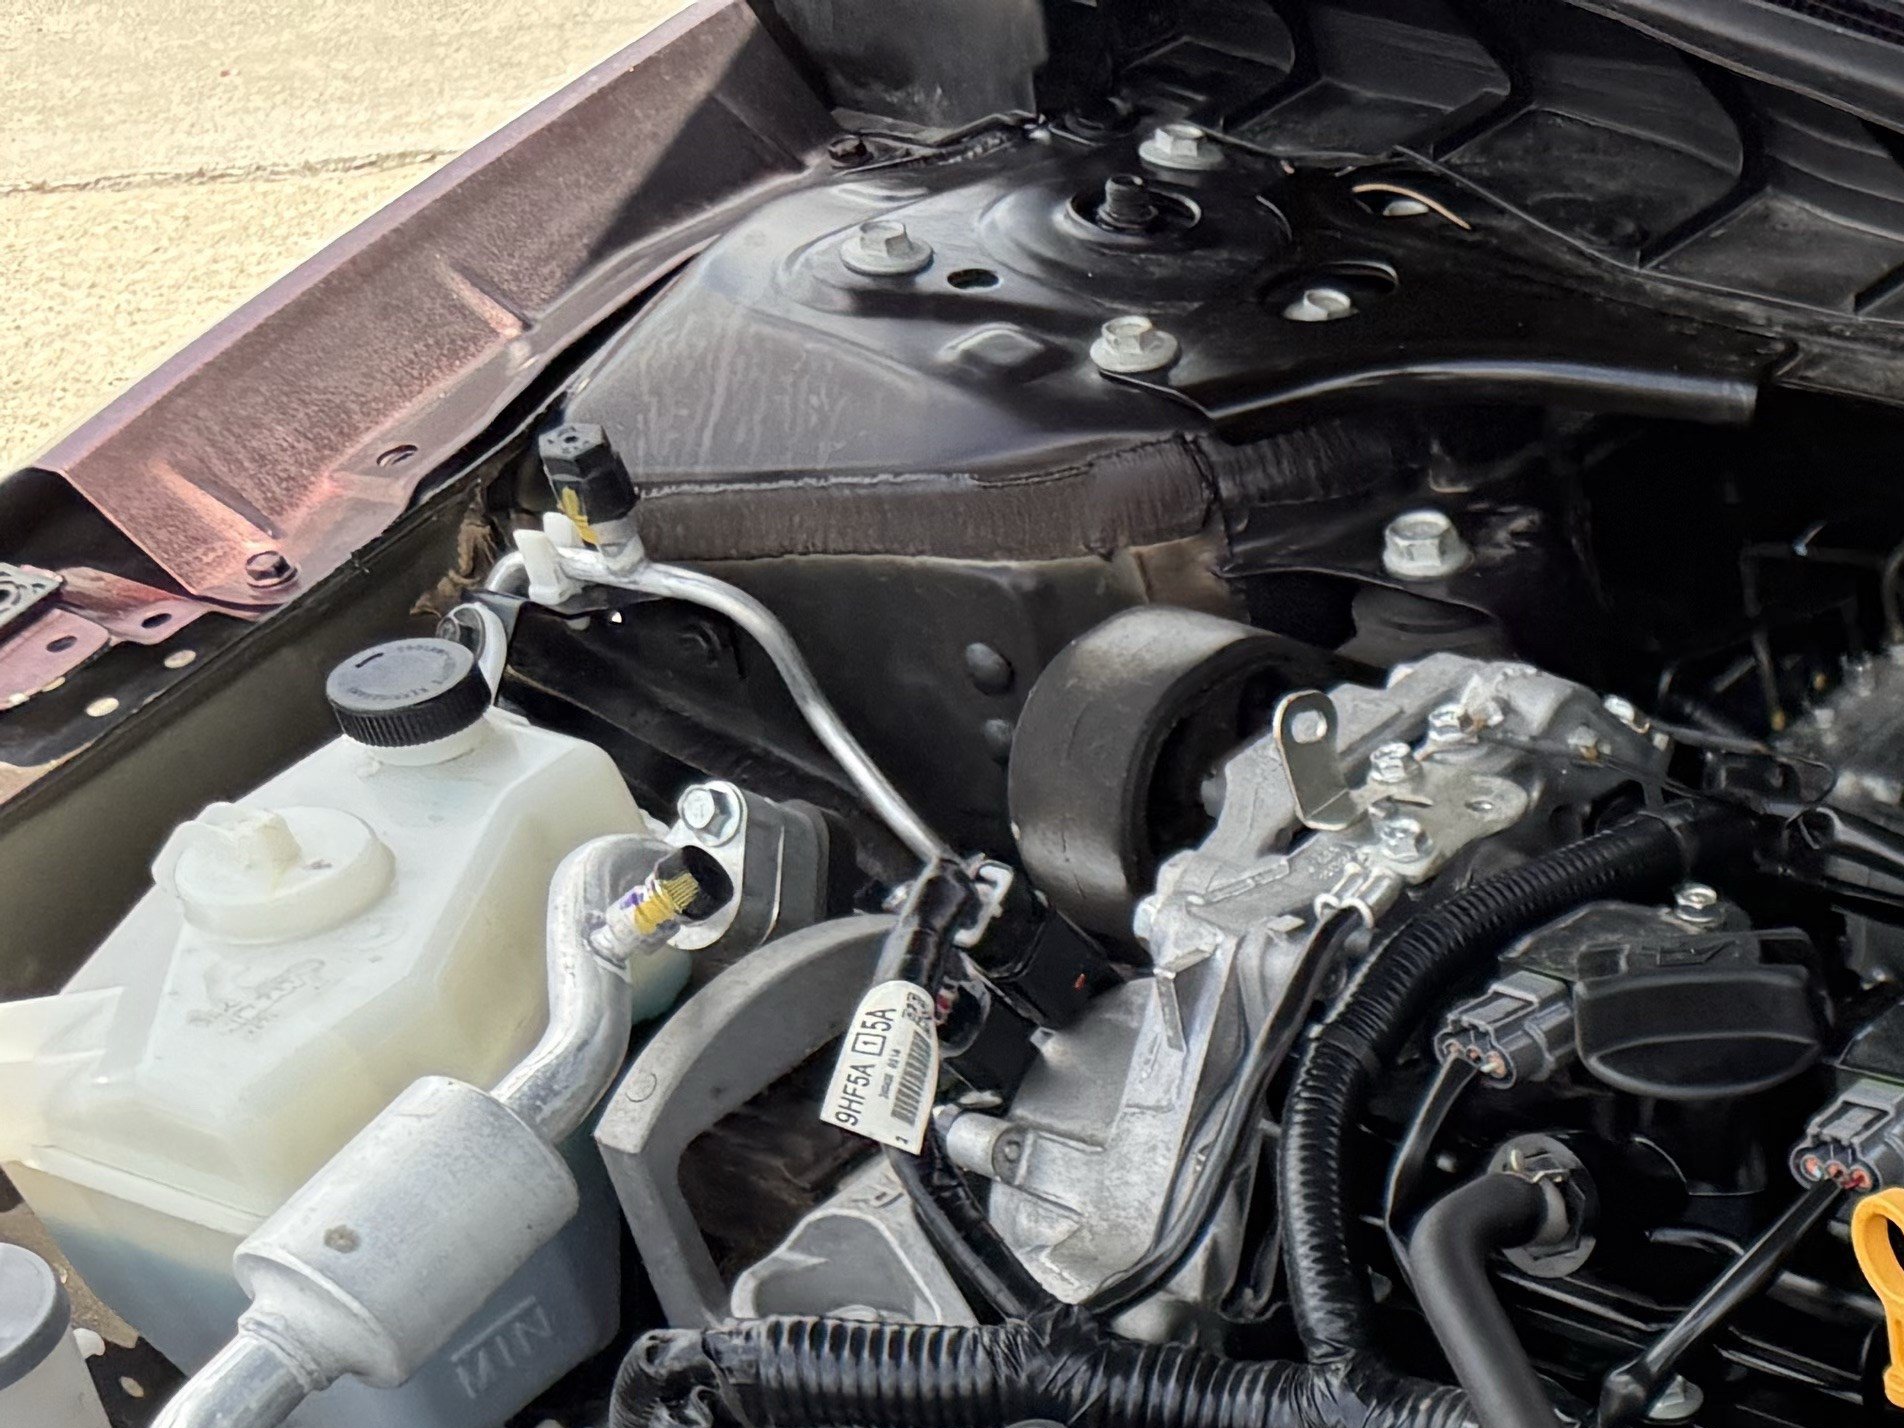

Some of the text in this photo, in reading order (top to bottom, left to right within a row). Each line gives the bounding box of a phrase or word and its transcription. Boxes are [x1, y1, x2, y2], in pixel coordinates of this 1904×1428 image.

[835, 1064, 875, 1126] 9HF5A
[860, 1007, 898, 1032] 5A
[456, 1305, 555, 1399] MIN
